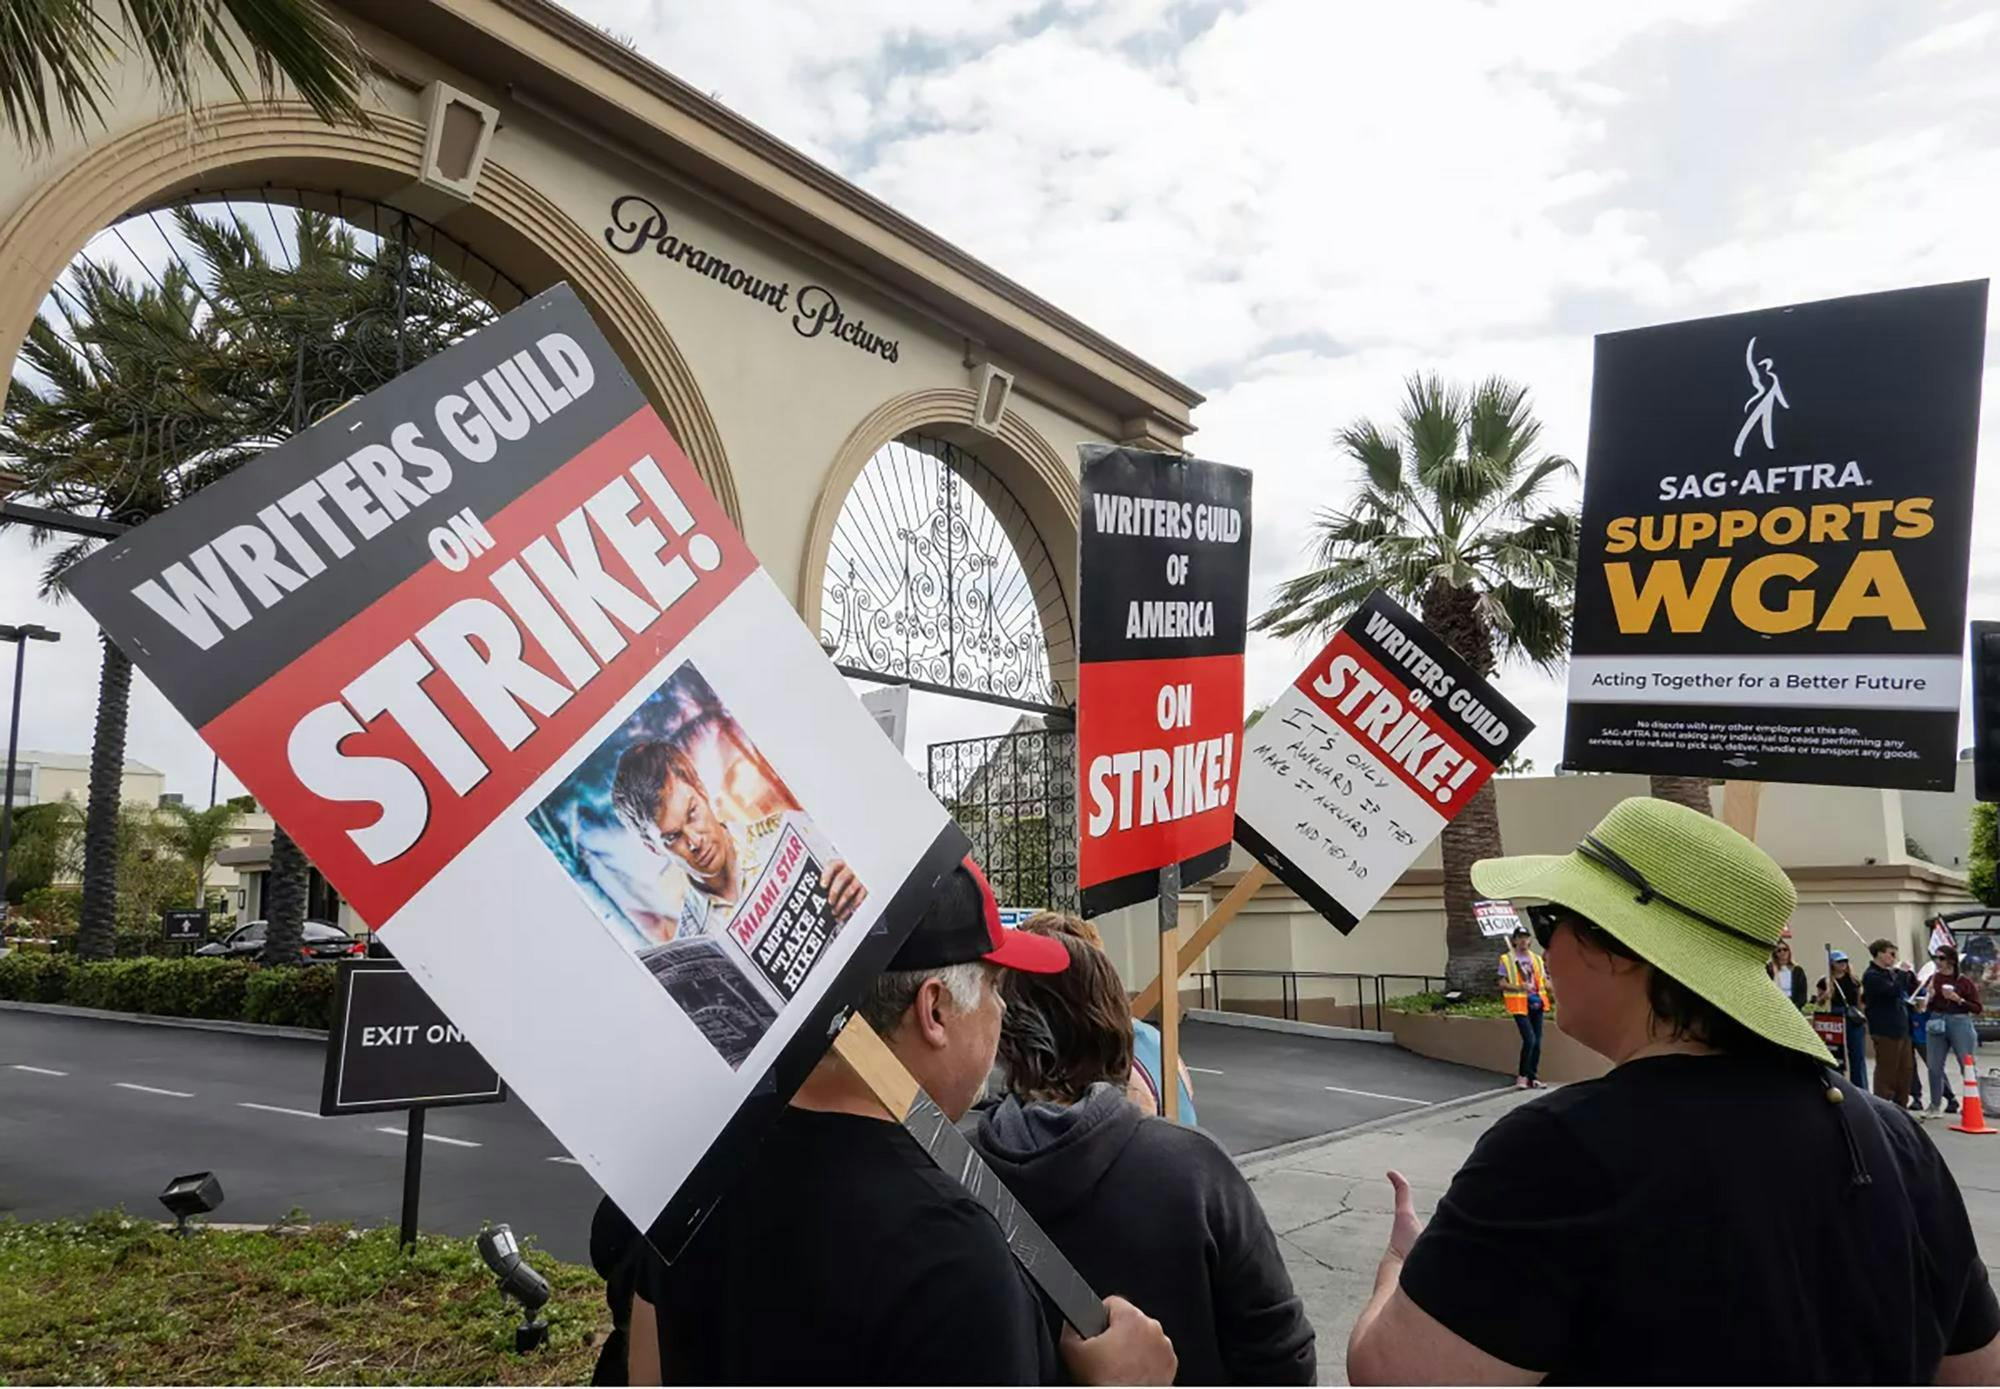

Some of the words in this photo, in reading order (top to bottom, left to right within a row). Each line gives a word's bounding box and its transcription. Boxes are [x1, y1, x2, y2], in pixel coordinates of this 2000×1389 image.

[605, 195, 789, 312] Paramount
[792, 285, 899, 363] Pictures
[131, 421, 453, 650] WRITERS
[434, 332, 595, 463] GUILD
[1093, 493, 1192, 539] WRITERS
[1195, 503, 1242, 543] GUILD
[427, 507, 496, 571] ON
[1604, 497, 1935, 554] SUPPORTS
[1166, 554, 1190, 585] OF
[1603, 550, 1927, 634] WGA
[1126, 601, 1215, 639] AMERICA
[287, 454, 722, 865] STRIKE!
[1364, 611, 1456, 698] WRITERS
[1448, 688, 1509, 746] GUILD
[1592, 672, 1647, 690] Acting
[1652, 672, 1733, 691] Together
[1738, 673, 1765, 689] for
[1769, 677, 1780, 689] a
[1786, 674, 1849, 690] Better
[1855, 674, 1927, 691] Future
[1157, 684, 1192, 730] ON
[1312, 654, 1478, 803] STRIKE!
[1408, 688, 1433, 712] ON
[1637, 720, 1650, 729] No
[1651, 721, 1685, 731] dispute
[1686, 722, 1707, 730] with
[1708, 724, 1726, 733] any
[1728, 723, 1753, 732] other
[1755, 725, 1801, 735] employer
[1804, 726, 1815, 734] at
[1816, 726, 1836, 735] this
[1636, 739, 1646, 747] to
[1647, 740, 1675, 748] refuse
[1687, 741, 1706, 751] pick
[1761, 744, 1796, 753] handle
[1810, 746, 1860, 757] transport
[1861, 749, 1881, 759] any
[1883, 749, 1921, 760] goods.
[1661, 730, 1676, 739] not
[1677, 731, 1709, 741] asking
[1710, 733, 1727, 742] any
[1778, 735, 1790, 743] to
[1821, 736, 1881, 747] performing
[1883, 739, 1905, 749] any
[1089, 732, 1234, 838] STRIKE!
[1253, 745, 1291, 776] MAKE
[1294, 778, 1314, 793] IT
[1313, 795, 1368, 840] AWKWARD
[1346, 753, 1390, 788] ONLY
[1295, 821, 1319, 841] AND
[1324, 838, 1348, 859] THEY
[1347, 860, 1368, 878] DID
[1360, 798, 1381, 814] IF
[1388, 820, 1417, 845] THEY
[737, 879, 781, 945] MIAMI
[776, 835, 803, 884] STAR
[758, 910, 793, 965] AMPTP
[789, 871, 819, 915] SAYS:
[770, 908, 816, 973] "TAKE
[811, 893, 827, 914] A
[783, 917, 826, 992] HIKE!"
[361, 1025, 419, 1047] EXIT
[426, 1025, 470, 1044] ON
